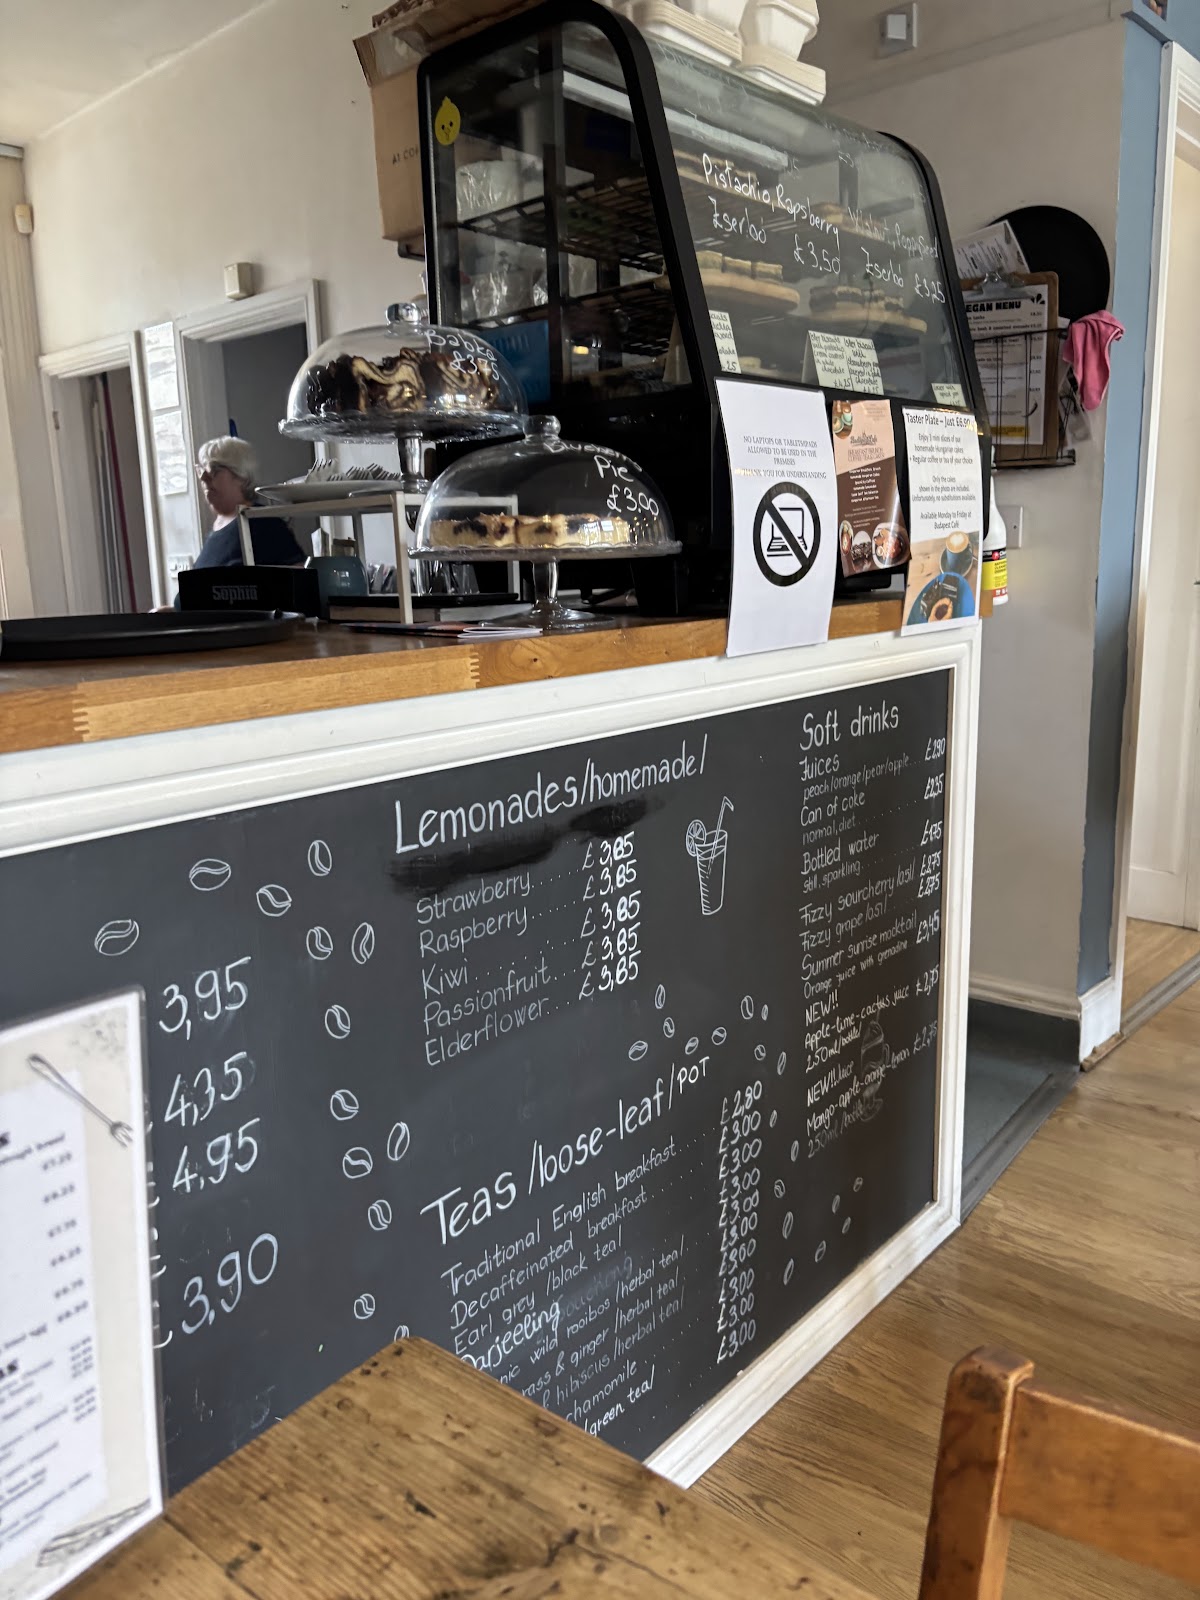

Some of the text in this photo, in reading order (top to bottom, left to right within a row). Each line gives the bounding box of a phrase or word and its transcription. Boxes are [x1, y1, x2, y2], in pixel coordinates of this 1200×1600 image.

[966, 301, 1021, 313] EGAN MENU
[425, 329, 498, 362] Babka
[450, 351, 500, 381] £3.75
[906, 412, 924, 424] Taster
[924, 414, 939, 426] Plate
[944, 416, 955, 428] Just
[918, 433, 928, 443] Enjoy
[748, 446, 771, 455] ALLOWED
[772, 447, 780, 455] TO
[752, 436, 774, 445] LAPTOPS
[914, 444, 935, 452] homemade
[935, 445, 954, 454] Hungarian
[594, 454, 634, 482] Pie
[786, 471, 827, 479] UNDERSTANDING
[912, 455, 927, 464] Regular
[927, 456, 938, 464] coffee
[932, 475, 941, 483] Only
[947, 475, 956, 483] cakes
[607, 484, 659, 516] £3.00
[920, 511, 937, 520] Available
[938, 511, 952, 519] Monday
[957, 511, 967, 519] Friday
[934, 521, 951, 530] Budapest
[800, 700, 899, 751] Soft drinks
[799, 754, 840, 782] Juices
[800, 789, 866, 826] Can of coke
[800, 830, 880, 875] Bottled water
[417, 872, 532, 924] Strawberry
[799, 902, 833, 926] Fizzy
[419, 907, 528, 958] Raspberry
[799, 928, 831, 951] Fizzy
[835, 912, 864, 943] grape
[801, 950, 844, 980] Summer
[847, 934, 878, 959] sunrise
[879, 909, 917, 943] mocktail
[422, 958, 468, 1000] Kiwi
[803, 978, 832, 999] Orange
[836, 965, 856, 987] juice
[860, 954, 874, 971] with
[423, 957, 551, 1035] Passionfruit
[805, 989, 839, 1027] NEW!!
[891, 984, 910, 1007] juice
[425, 997, 549, 1066] Elderflower
[419, 1171, 518, 1245] Teas
[440, 1217, 541, 1296] Traditional
[552, 1181, 607, 1232] English
[614, 1136, 678, 1191] breakfast
[450, 1231, 574, 1329] Decaffeinated
[587, 1187, 649, 1240] breakfast
[454, 1313, 493, 1355] Earl
[502, 1291, 535, 1324] grey
[530, 1329, 558, 1364] wild
[567, 1298, 611, 1338] rooibos
[555, 1350, 565, 1378] &
[570, 1328, 609, 1367] ginger
[556, 1353, 610, 1406] hibiscus
[565, 1358, 637, 1423] chamomile
